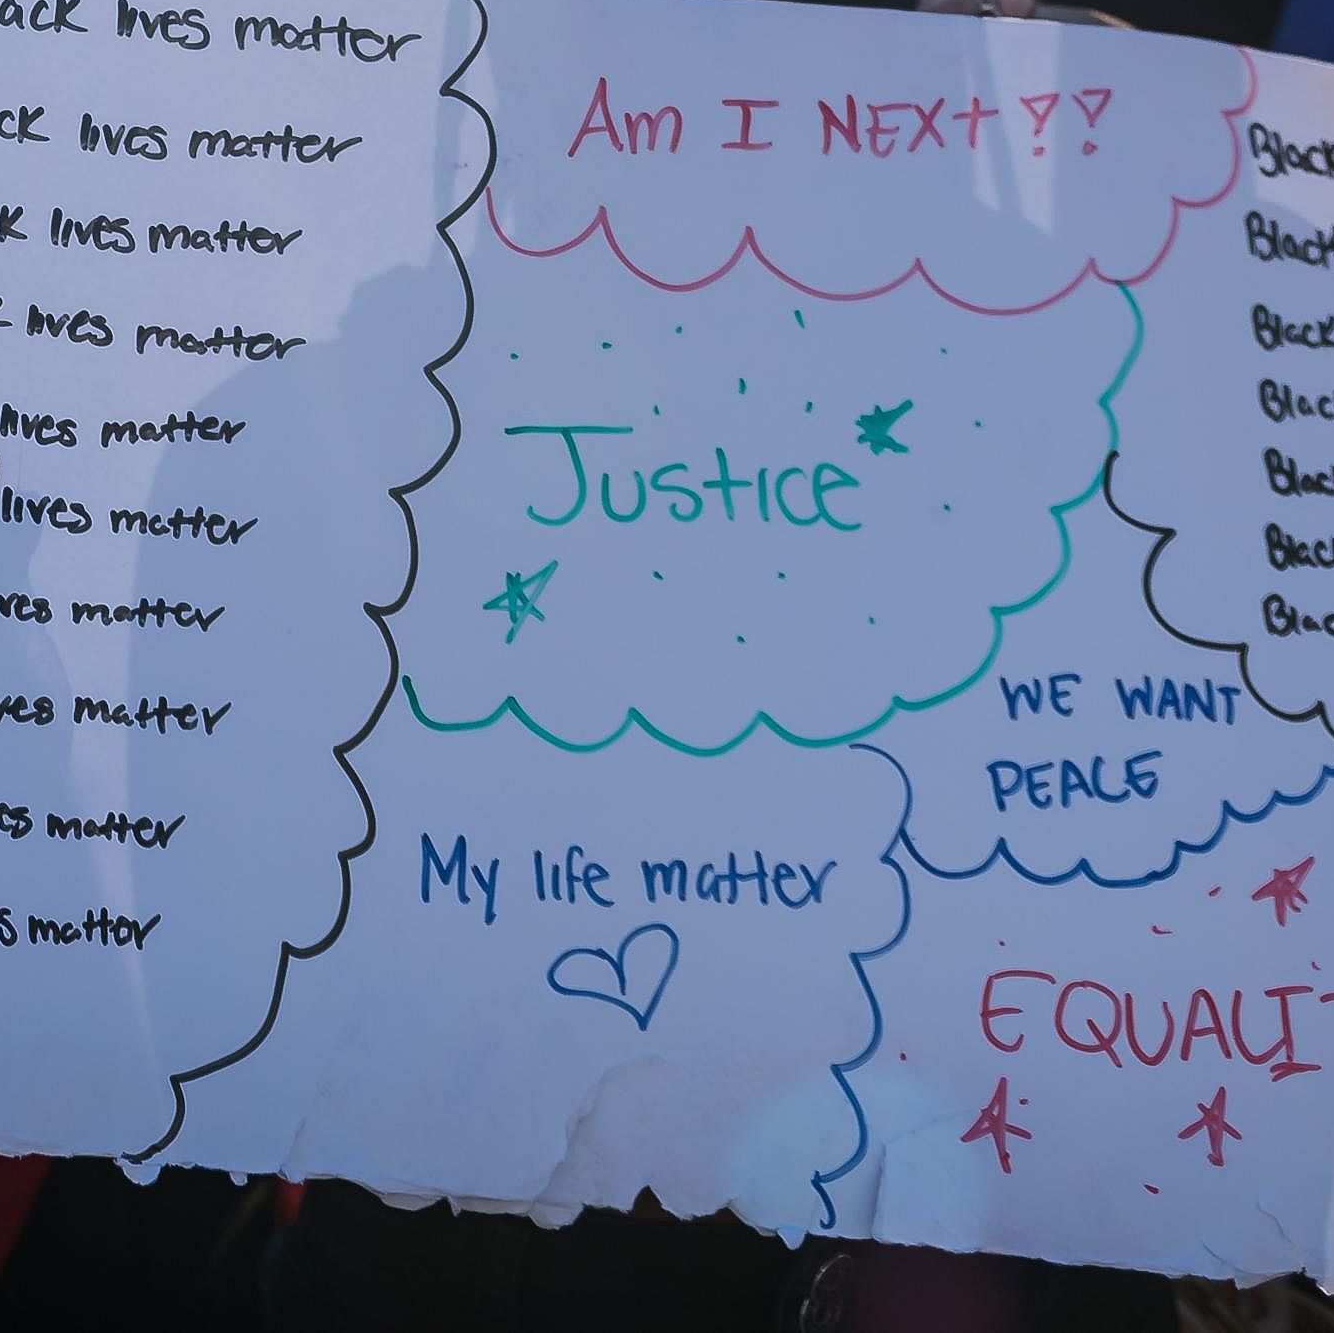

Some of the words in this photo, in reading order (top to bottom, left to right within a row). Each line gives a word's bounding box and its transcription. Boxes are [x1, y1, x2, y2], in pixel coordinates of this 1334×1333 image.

[234, 15, 423, 63] matter
[79, 112, 168, 161] lives
[188, 124, 363, 164] matter
[567, 76, 684, 158] Am
[720, 98, 780, 151] I
[50, 207, 136, 254] lives
[148, 220, 303, 255] matter
[26, 303, 114, 347] lives
[135, 324, 307, 361] matter
[0, 402, 78, 448] lives
[100, 410, 247, 449] matter
[1, 485, 93, 535] lives
[109, 505, 259, 546] matter
[71, 597, 226, 633] matter
[73, 696, 232, 736] matter
[999, 672, 1082, 721] WE
[1114, 675, 1242, 726] WANT
[985, 750, 1164, 813] PEACE
[46, 811, 186, 849] matter
[420, 832, 500, 926] My
[533, 845, 615, 908] life
[640, 850, 838, 910] matter
